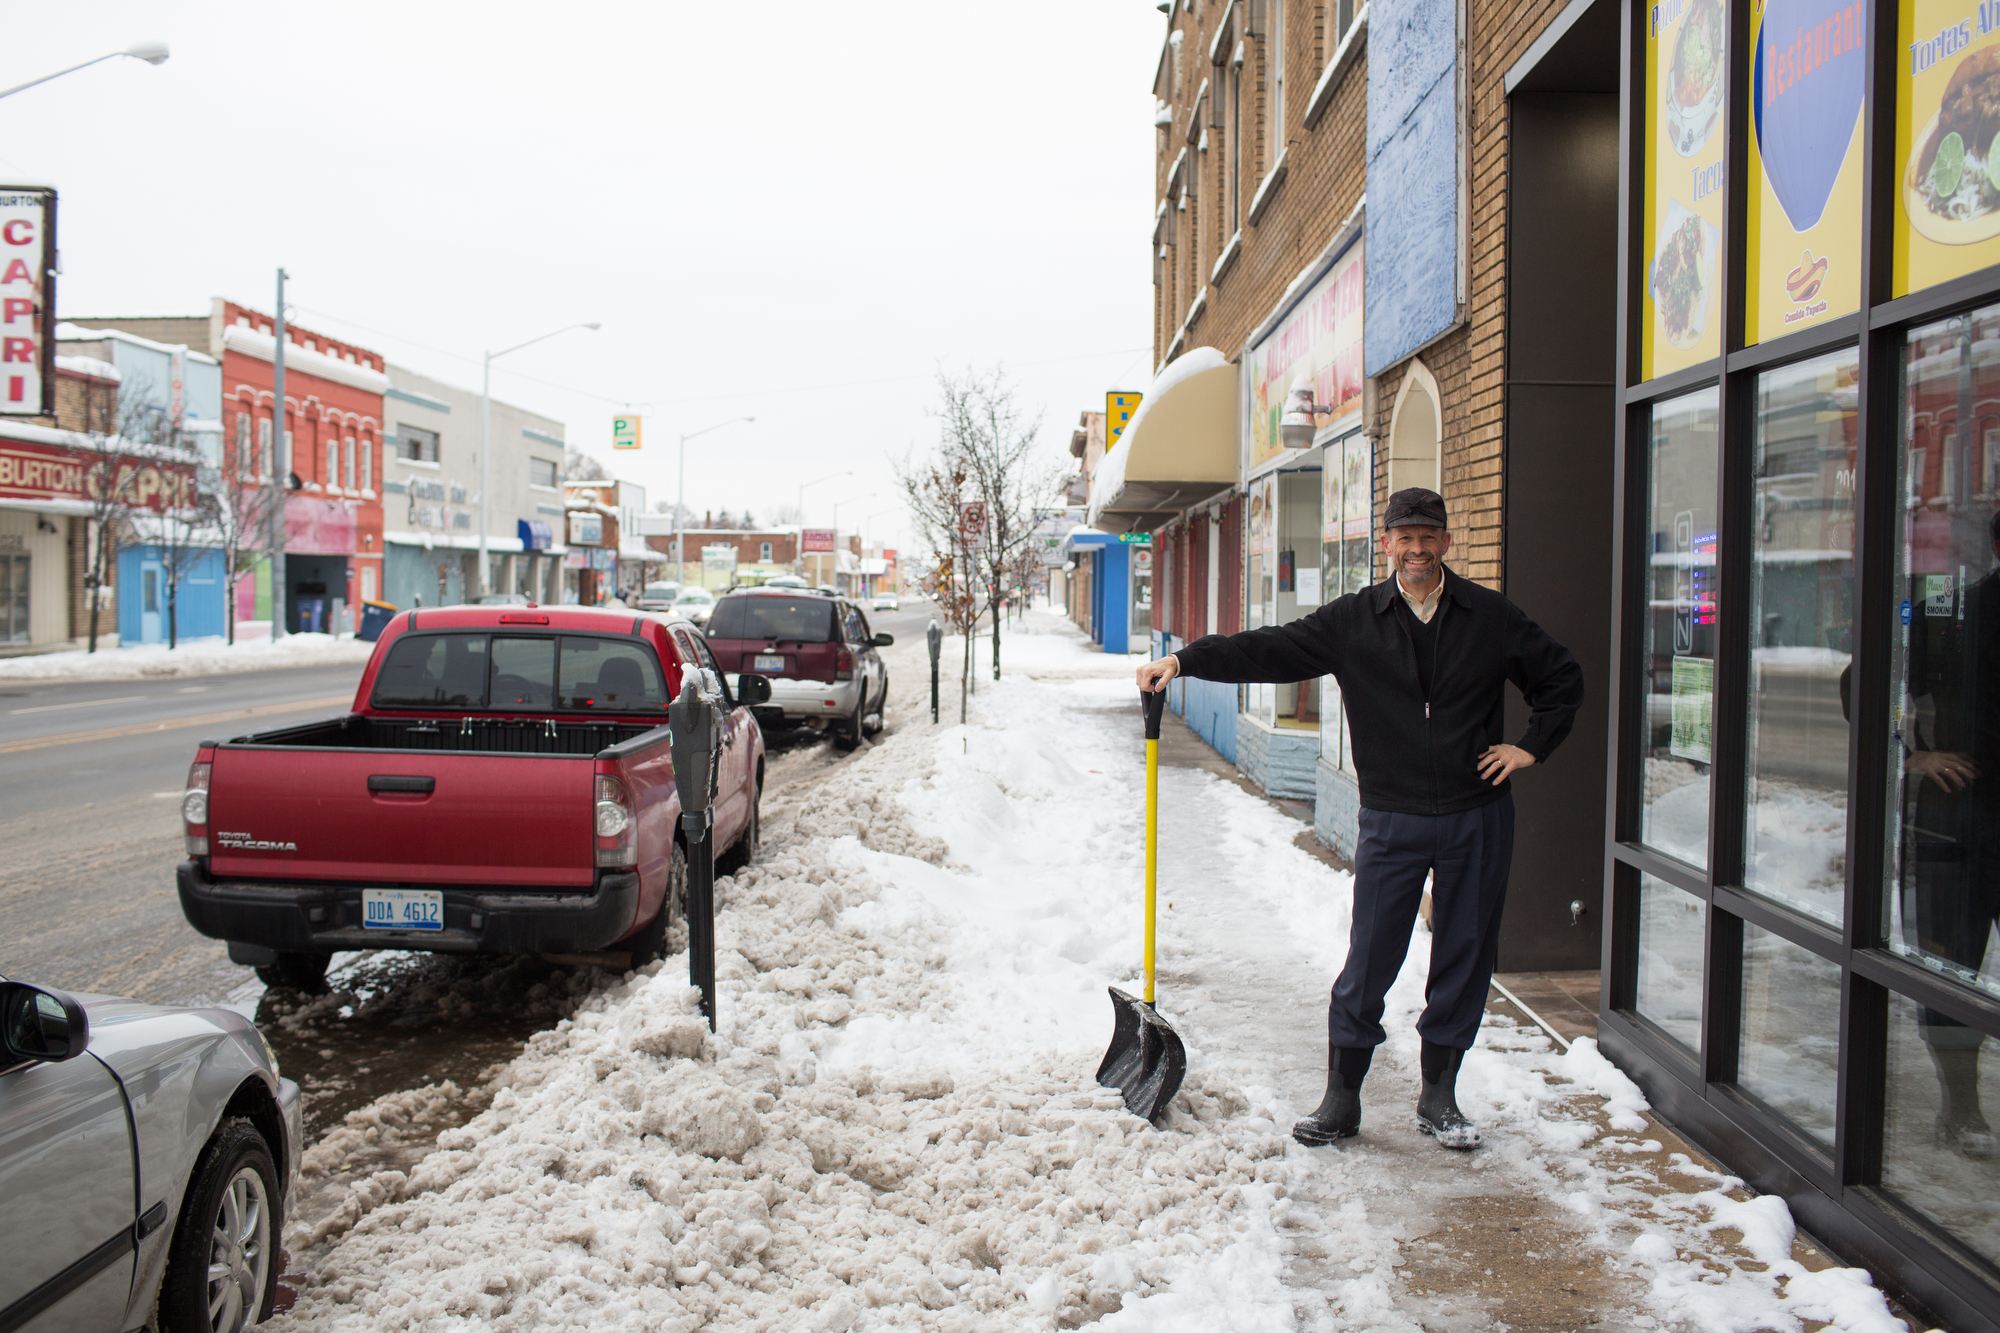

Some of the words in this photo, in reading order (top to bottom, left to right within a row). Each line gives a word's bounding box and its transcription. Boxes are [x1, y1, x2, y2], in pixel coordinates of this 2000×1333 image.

[1651, 0, 1684, 39] Pozole
[1767, 0, 1862, 108] Restaurant
[1909, 17, 1971, 77] Tortas
[0, 195, 42, 207] URTON
[1, 219, 35, 401] CAPRI
[1784, 307, 1805, 324] Comida
[0, 456, 83, 493] BURTON
[1936, 595, 1945, 604] NO
[217, 831, 252, 840] TOYOTA
[218, 840, 299, 852] TACOMA
[368, 901, 394, 920] DDA
[403, 902, 439, 922] 4612
